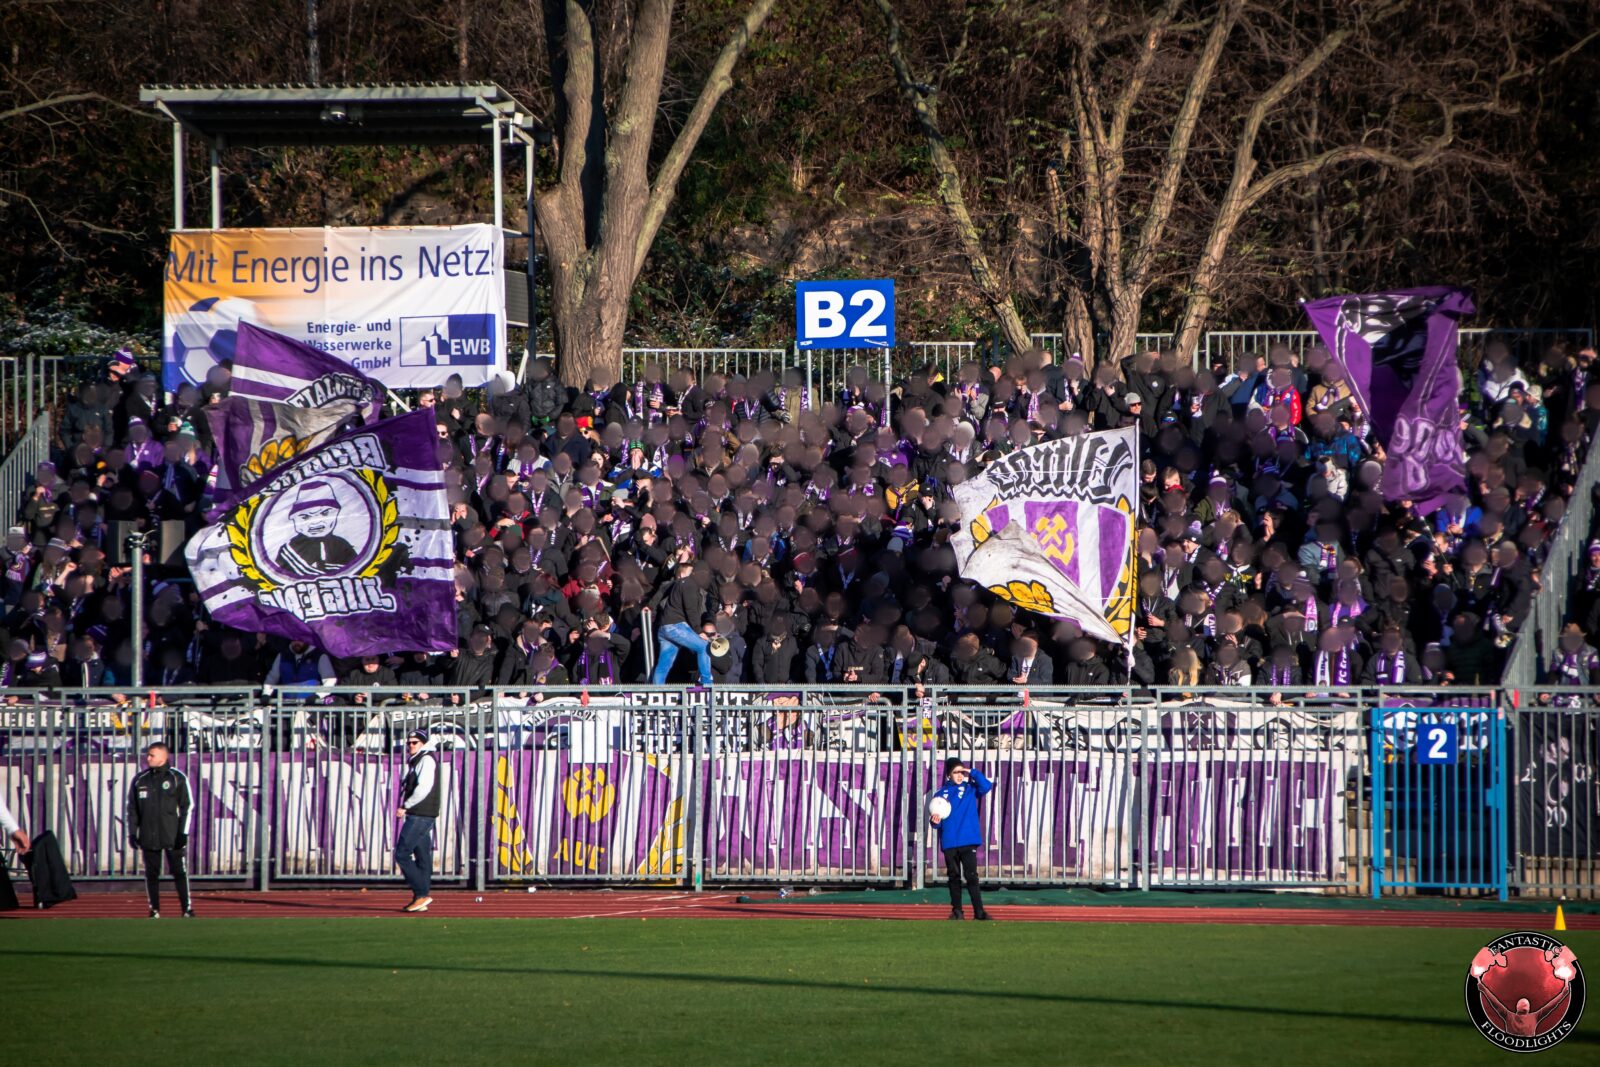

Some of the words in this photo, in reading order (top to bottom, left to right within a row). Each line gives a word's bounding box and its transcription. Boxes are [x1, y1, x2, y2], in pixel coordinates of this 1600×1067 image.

[164, 249, 218, 284] Mit
[232, 247, 349, 293] Energie
[360, 247, 403, 281] ins
[419, 242, 495, 279] Netz!
[804, 289, 887, 339] B2
[307, 321, 361, 336] Energie-
[366, 318, 391, 332] und
[450, 338, 491, 356] EWB
[351, 356, 391, 369] GmbH
[1428, 728, 1448, 759] 2
